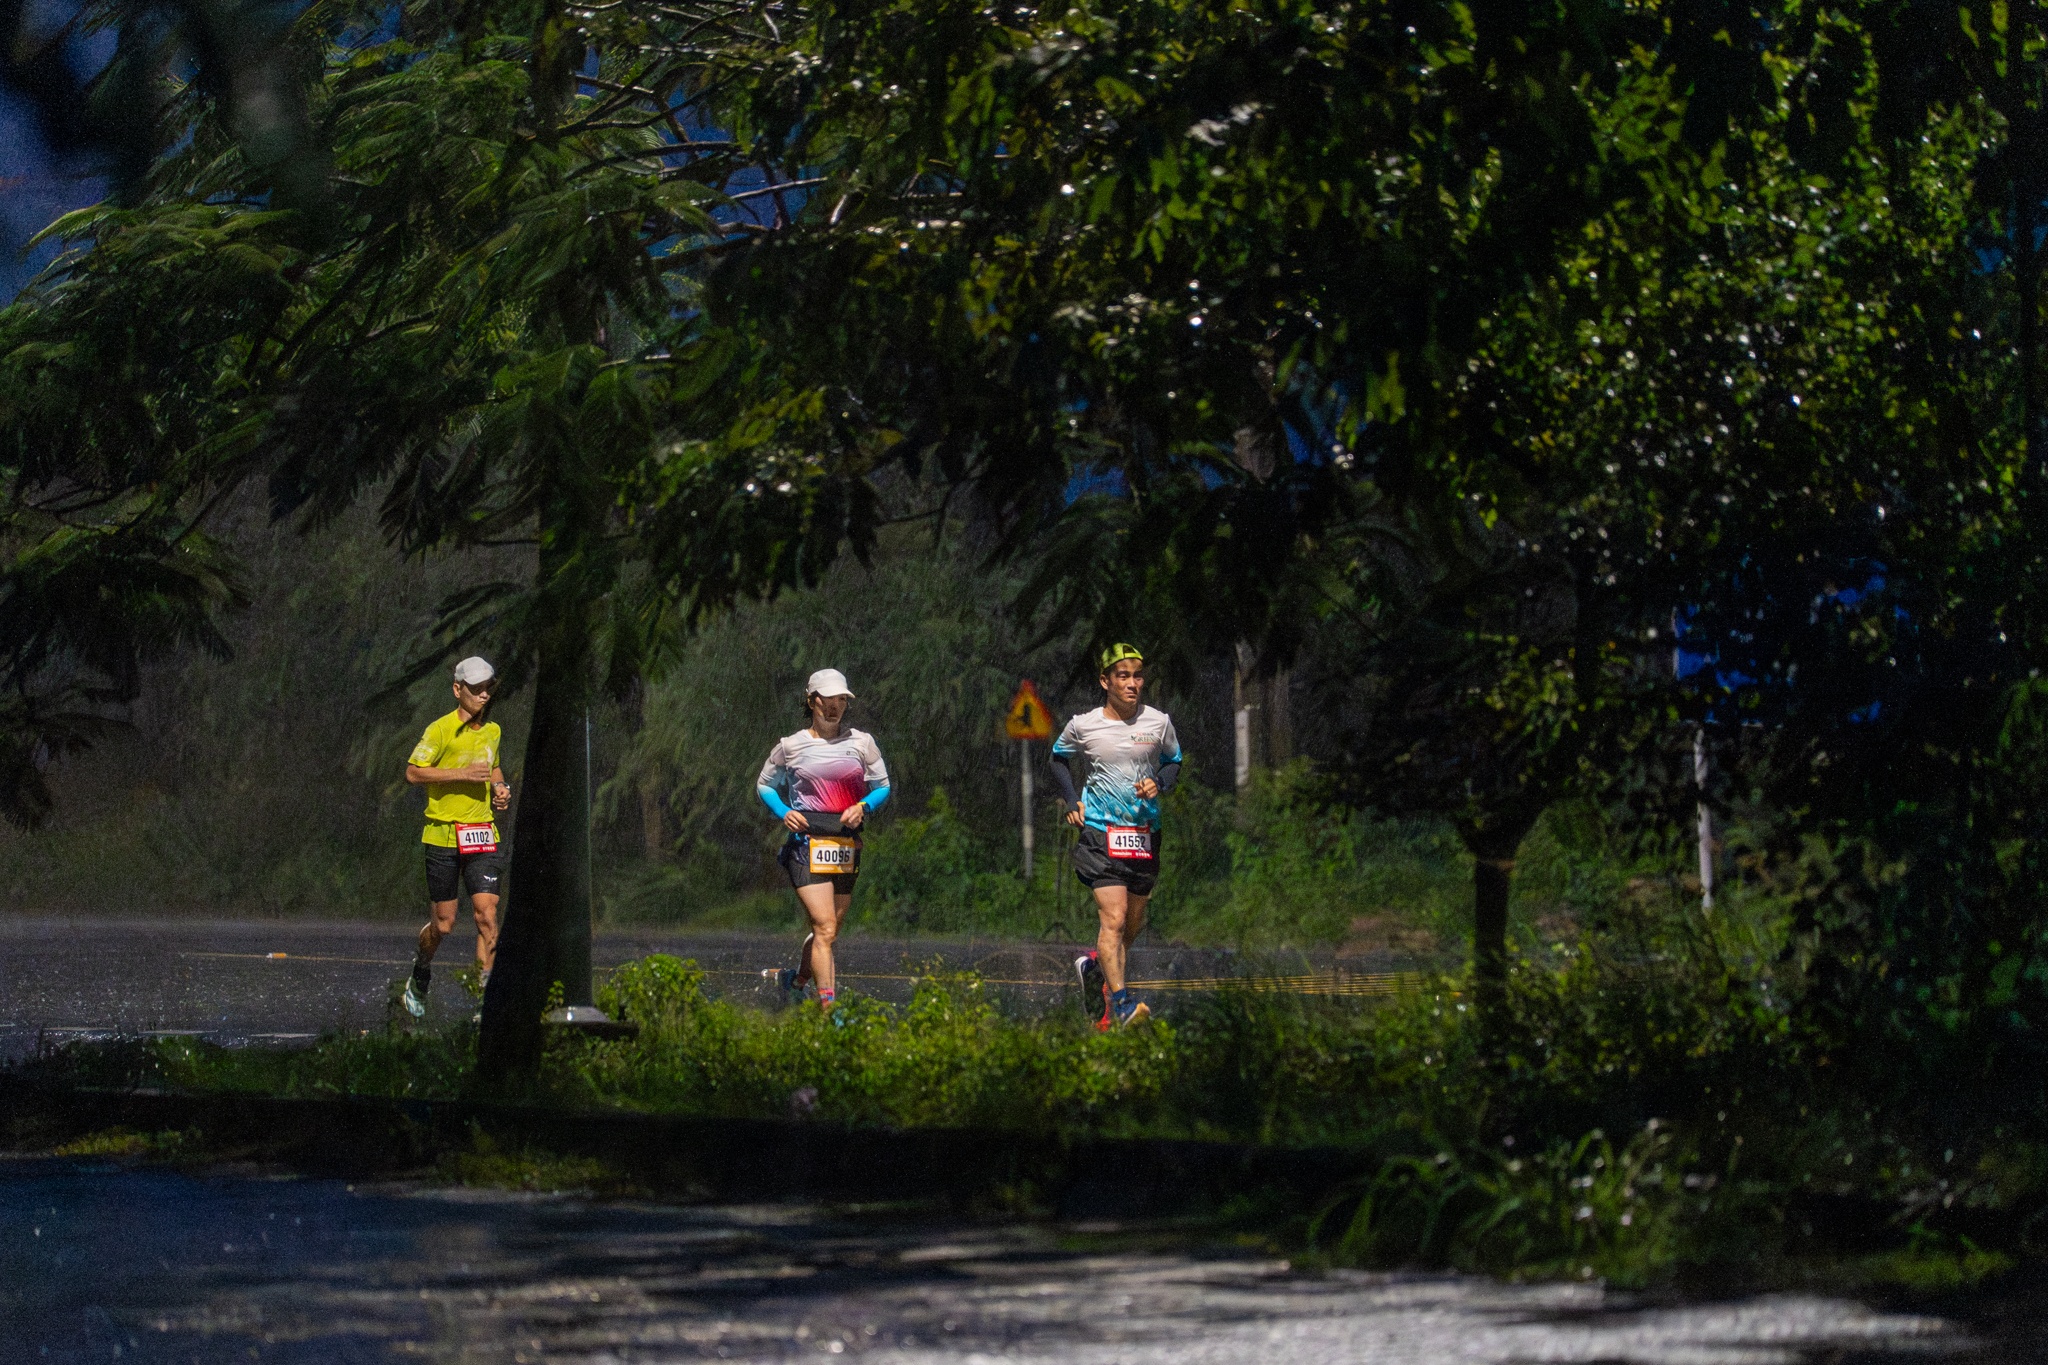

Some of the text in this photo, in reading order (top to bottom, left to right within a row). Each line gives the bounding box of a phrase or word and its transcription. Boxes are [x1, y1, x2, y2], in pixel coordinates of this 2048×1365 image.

[465, 831, 490, 843] 41102
[1115, 835, 1146, 848] 41552
[816, 850, 851, 862] 40096
